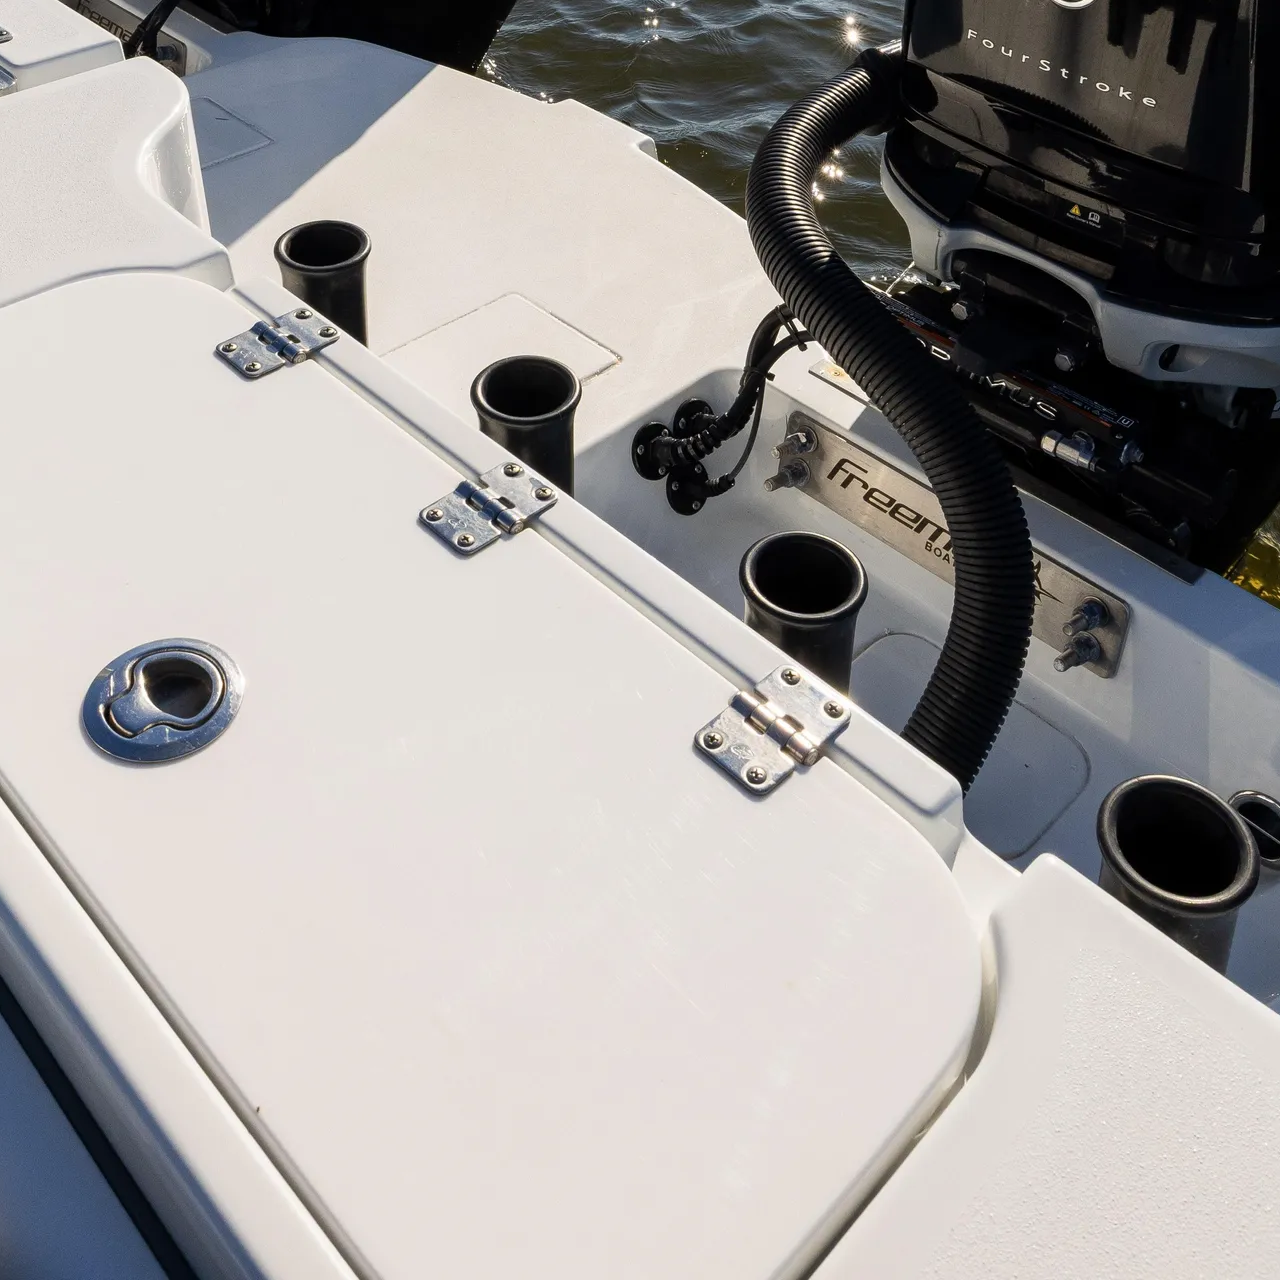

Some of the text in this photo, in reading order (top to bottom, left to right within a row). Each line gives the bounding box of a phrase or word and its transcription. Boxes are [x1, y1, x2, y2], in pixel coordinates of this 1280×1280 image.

[967, 28, 1157, 108] FourStroke
[916, 336, 1059, 421] PMUS
[826, 457, 954, 552] Freem
